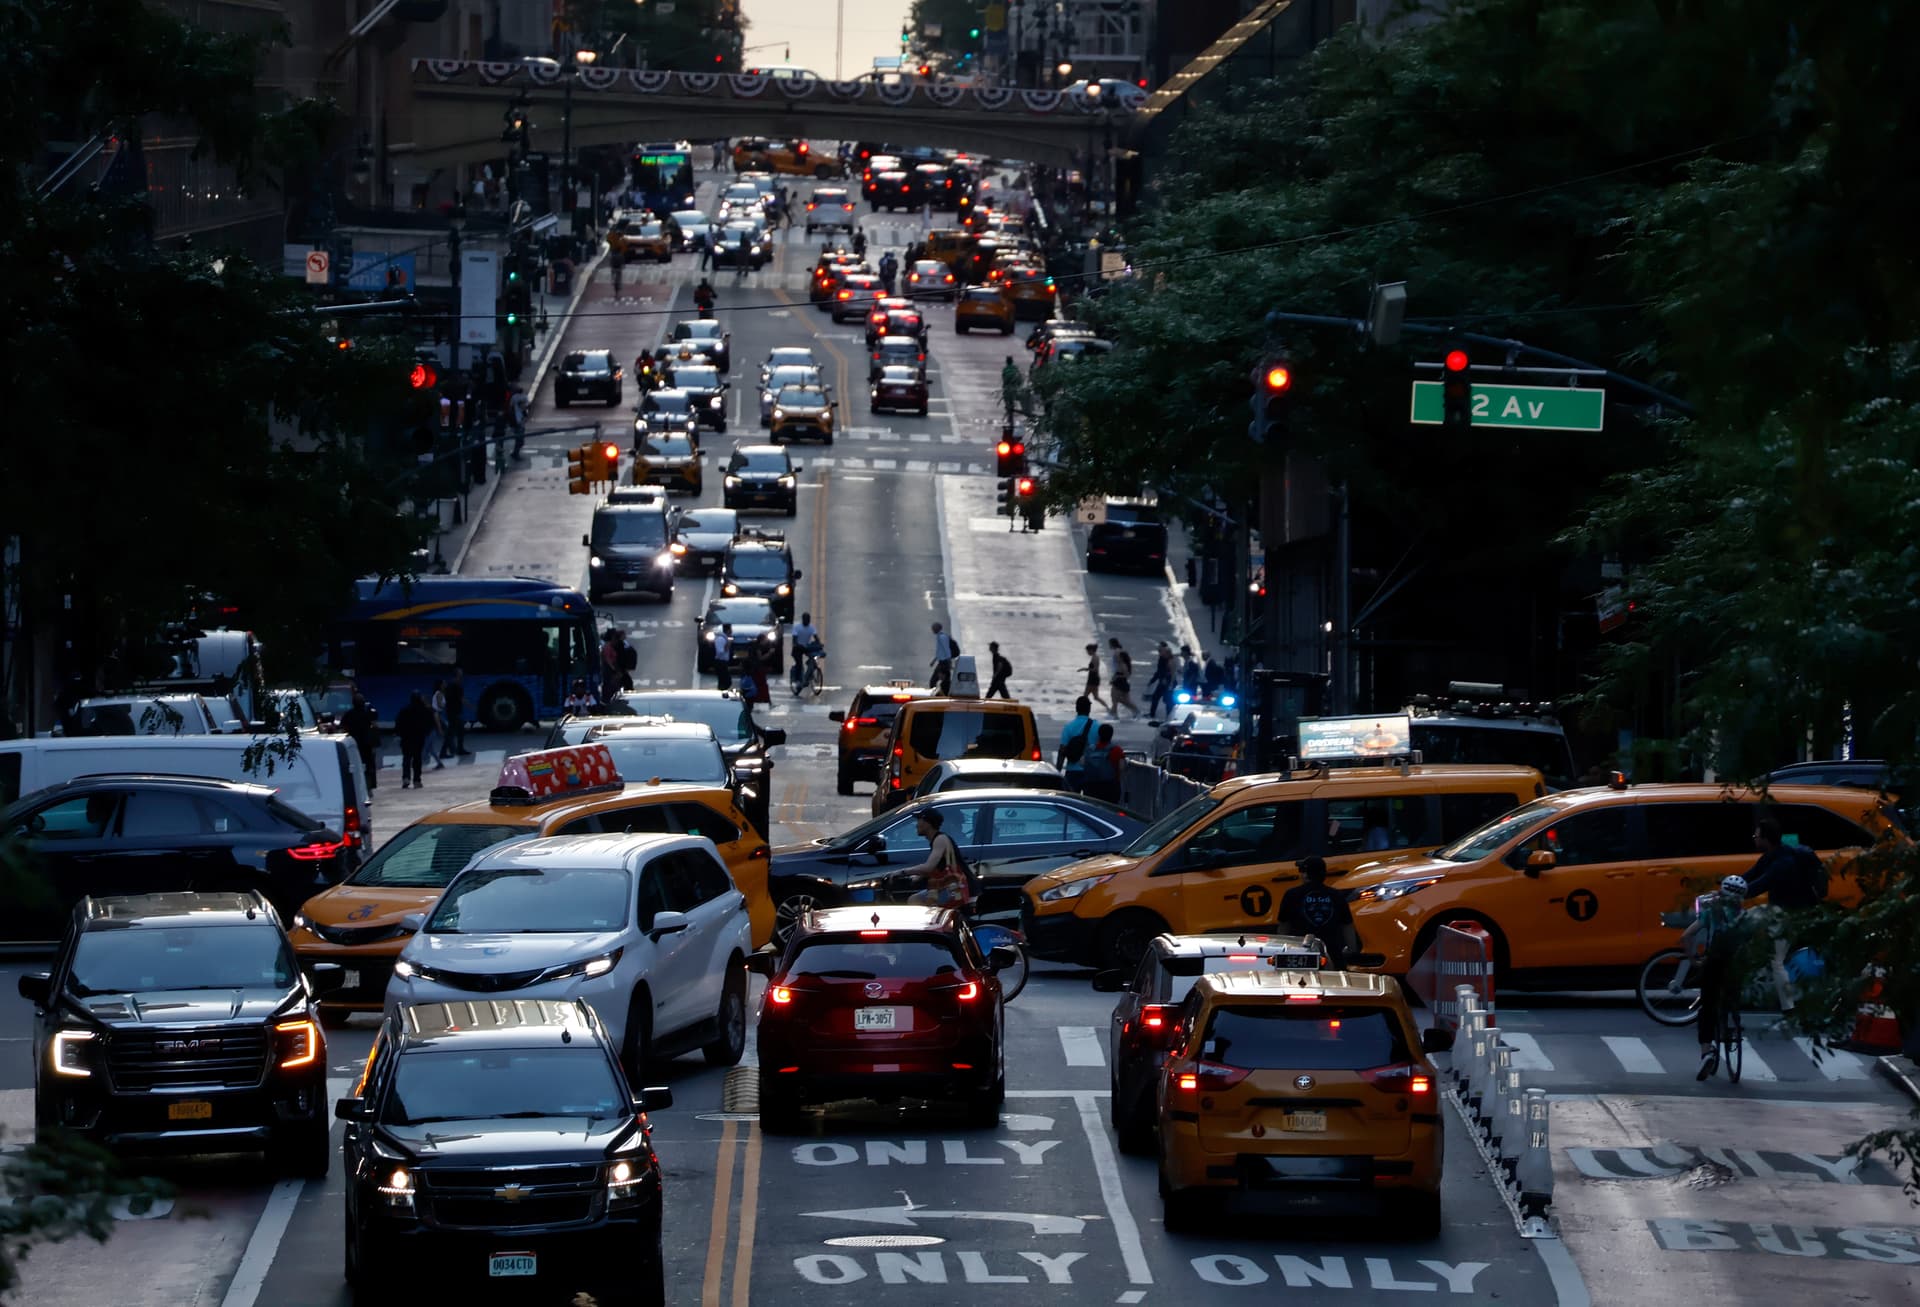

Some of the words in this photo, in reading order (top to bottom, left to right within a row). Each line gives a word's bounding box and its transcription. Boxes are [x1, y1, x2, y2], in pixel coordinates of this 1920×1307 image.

[1471, 393, 1489, 417] 2
[1502, 395, 1545, 419] Av
[791, 1139, 1062, 1167] ONLY
[1655, 1218, 1920, 1264] BUS
[793, 1251, 1090, 1286] ONLY
[1191, 1254, 1492, 1294] ONLY
